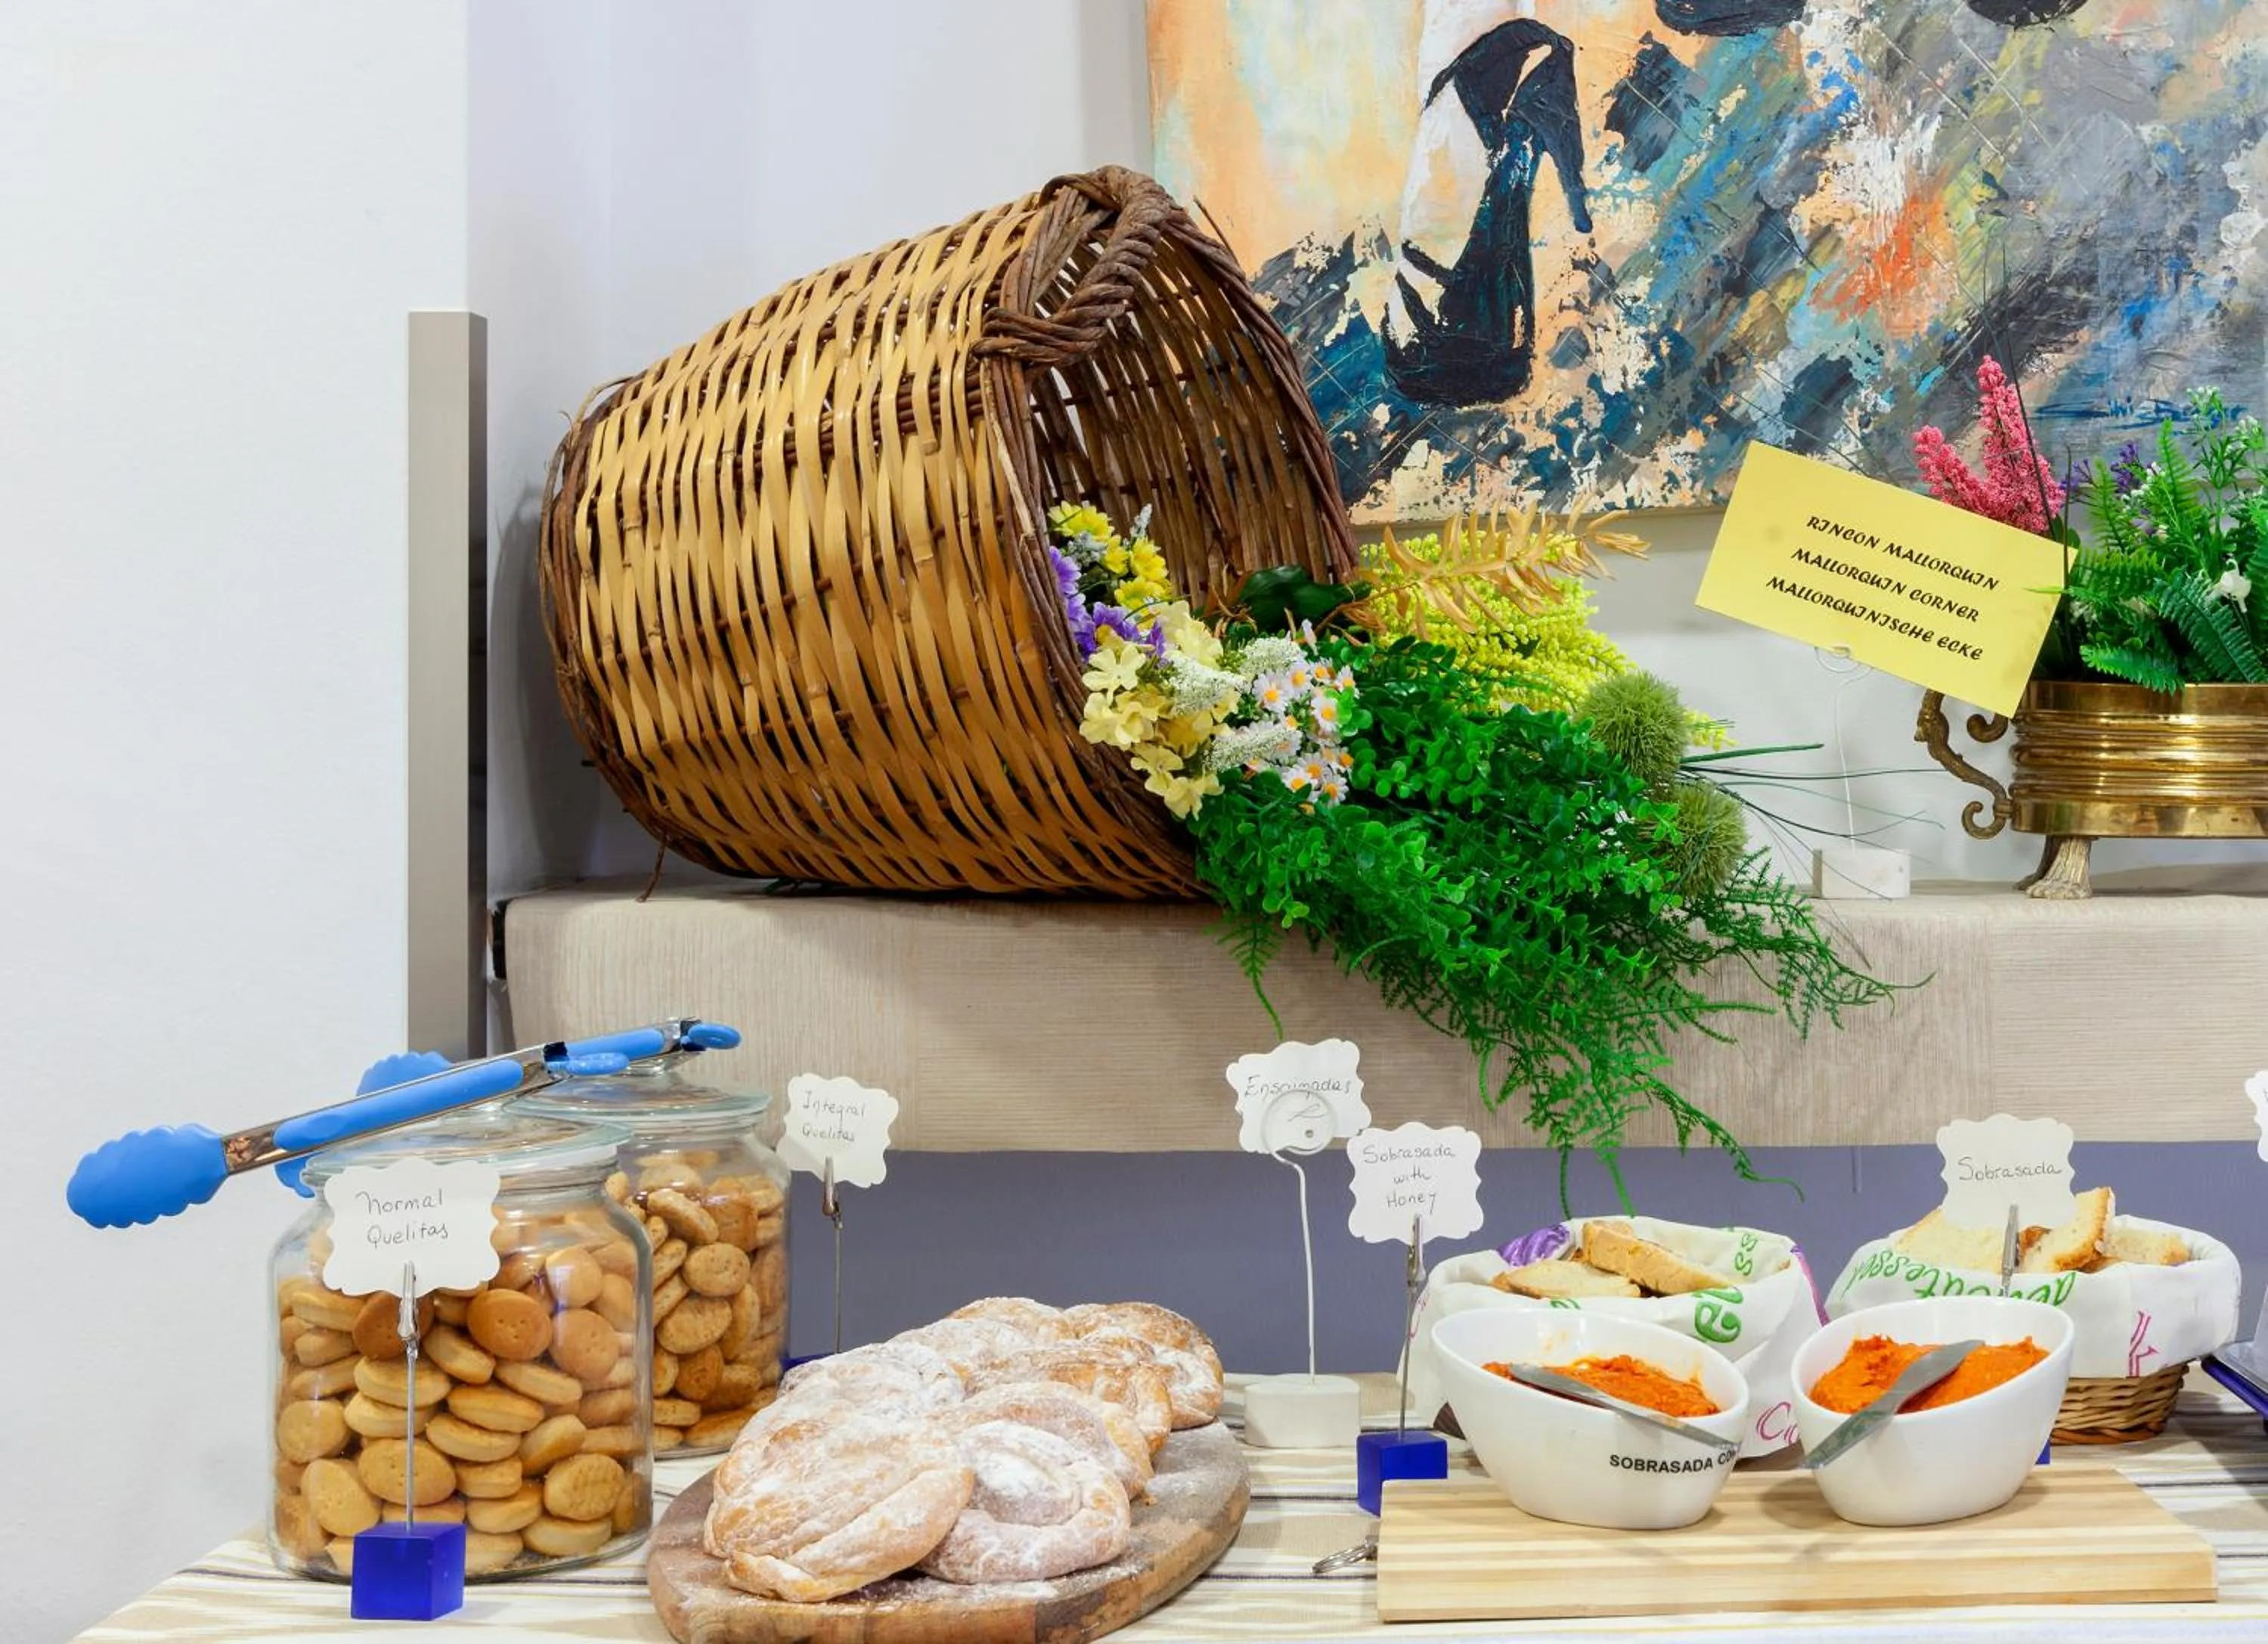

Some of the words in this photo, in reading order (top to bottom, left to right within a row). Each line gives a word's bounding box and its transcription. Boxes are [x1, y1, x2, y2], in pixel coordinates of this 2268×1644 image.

[1806, 516, 1881, 549] RINCON
[1882, 541, 2000, 591] MALLORQUIN
[1790, 547, 1907, 596] MALLORQUIN
[1909, 588, 1980, 623] CORNER
[1765, 575, 1935, 643] MALLORQUINISCHE
[1936, 635, 1984, 661] ECKE
[1362, 1143, 1456, 1164] Sobrasada
[1957, 1155, 2063, 1181] Sobrasada
[1387, 1189, 1437, 1215] Honey
[366, 1221, 449, 1249] Quelitas
[1609, 1453, 1714, 1475] SOBRASADA
